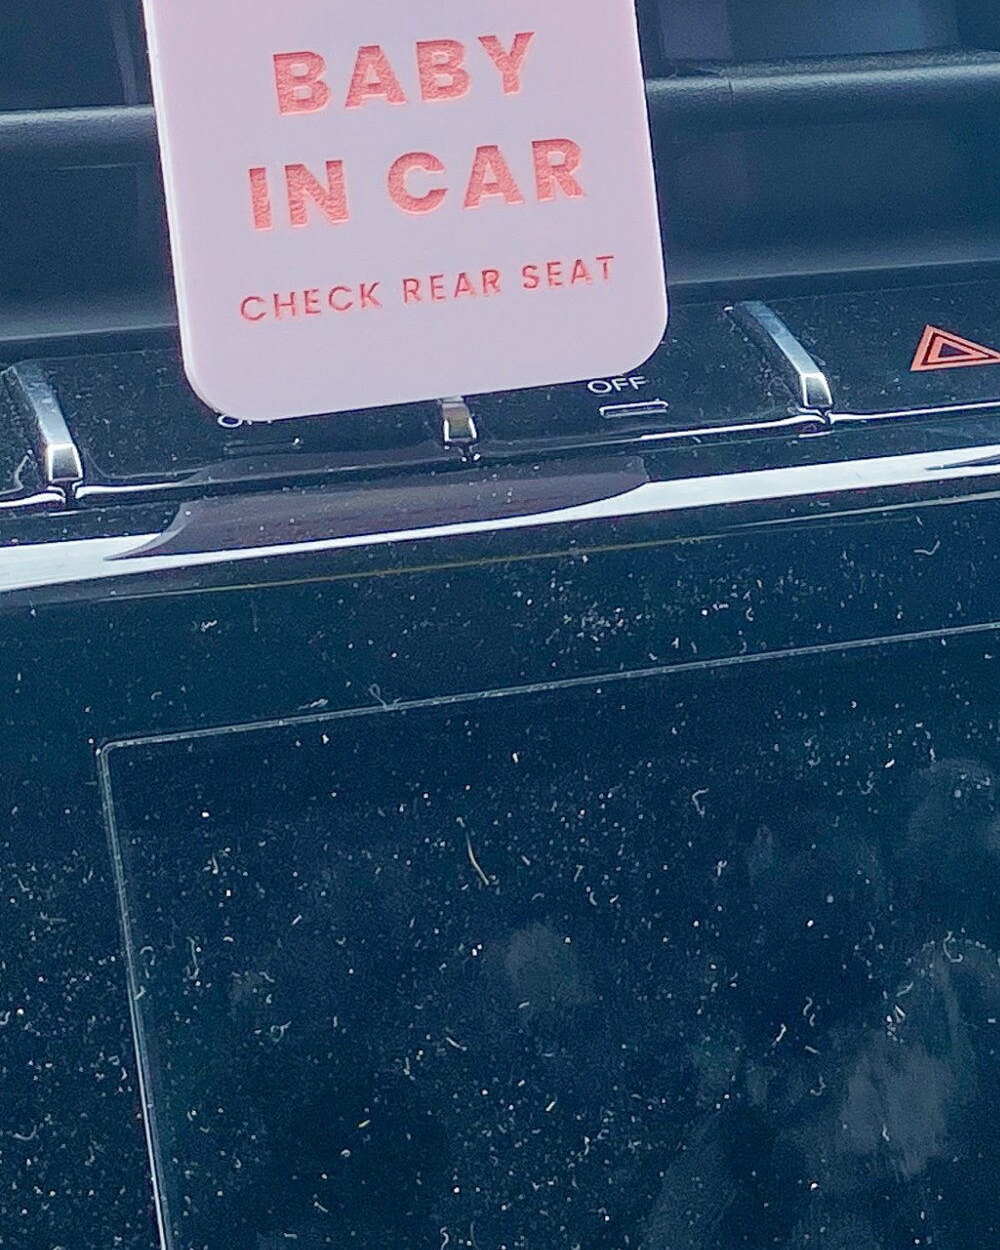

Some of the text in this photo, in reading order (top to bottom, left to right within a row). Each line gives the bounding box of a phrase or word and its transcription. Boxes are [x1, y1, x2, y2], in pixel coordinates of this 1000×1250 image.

[273, 32, 534, 113] BABY
[249, 139, 582, 228] IN CAR
[241, 256, 614, 321] CHECK REAR SEAT
[587, 376, 647, 394] OFF
